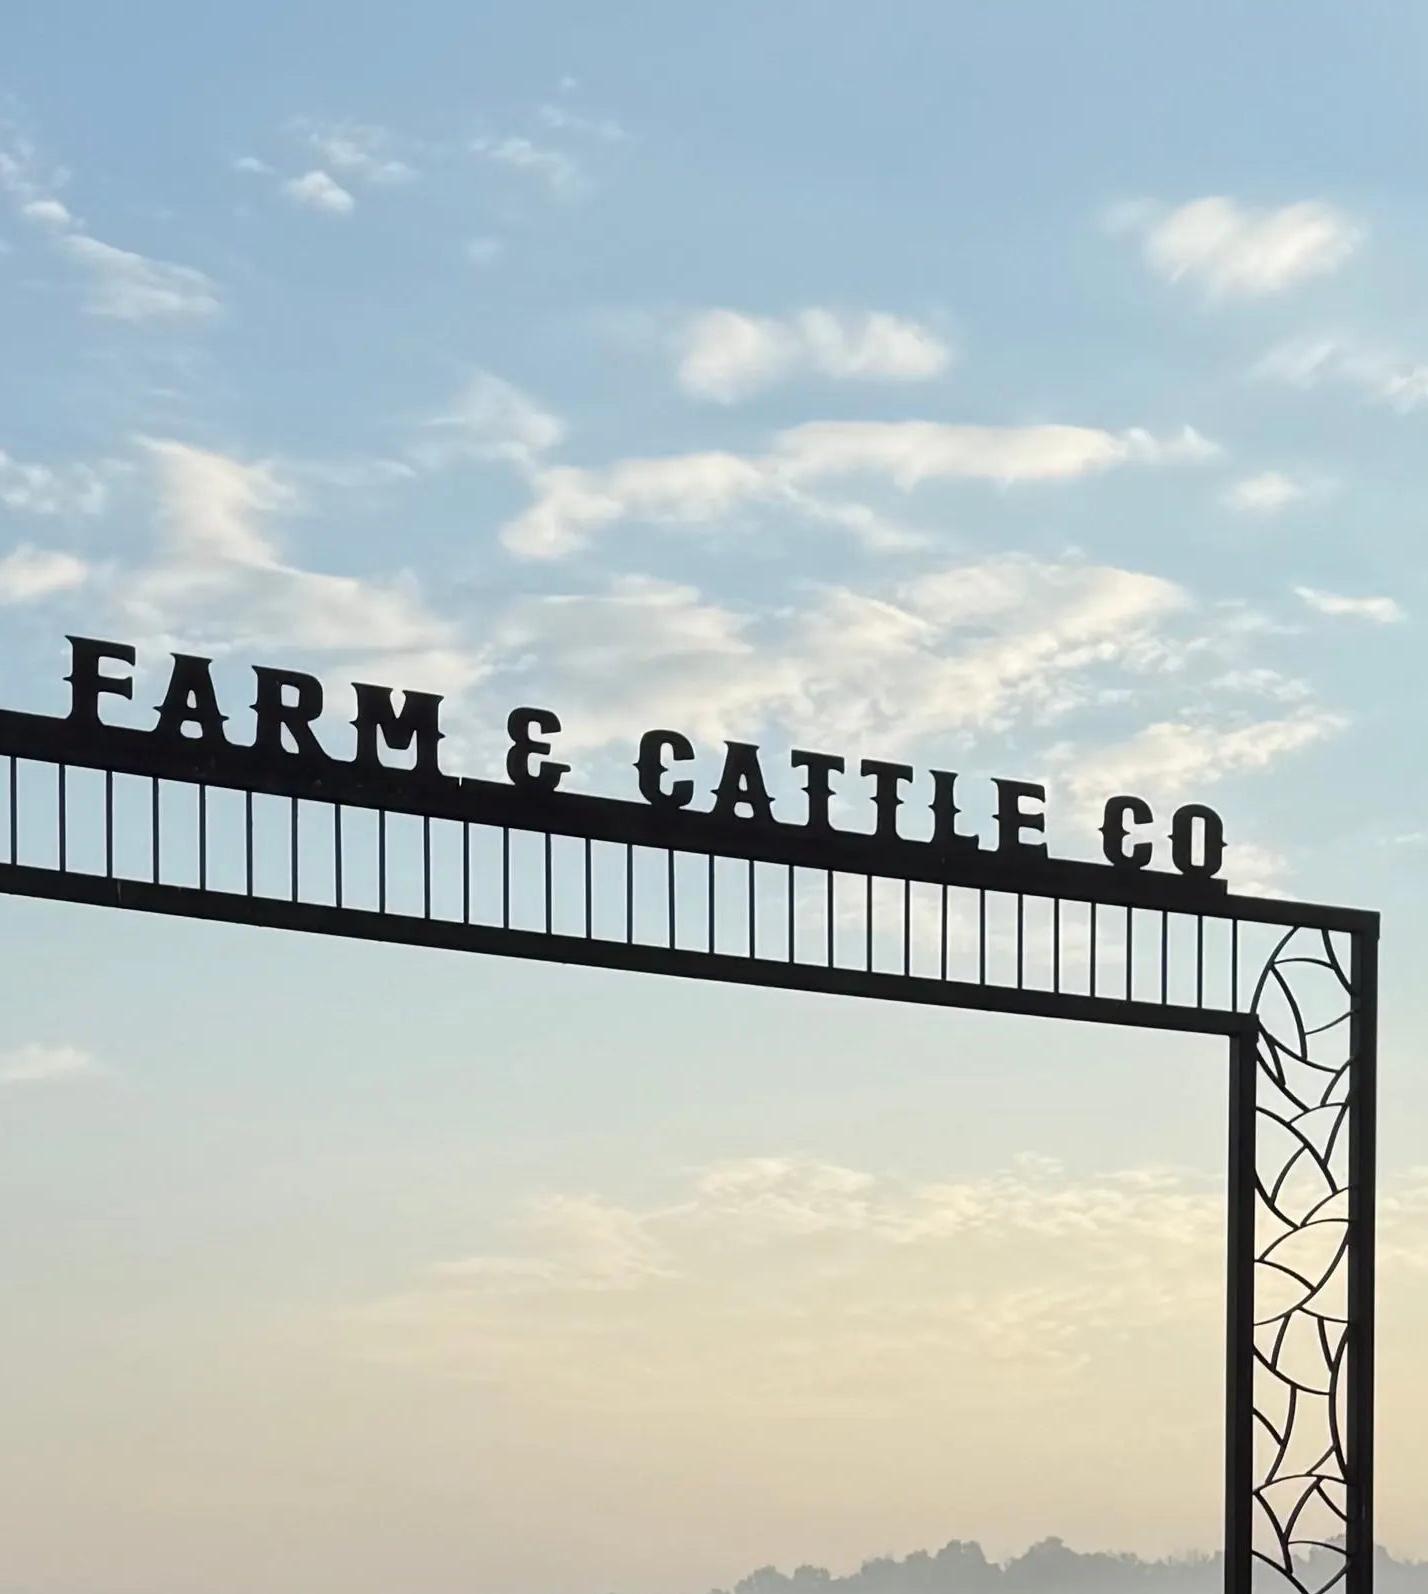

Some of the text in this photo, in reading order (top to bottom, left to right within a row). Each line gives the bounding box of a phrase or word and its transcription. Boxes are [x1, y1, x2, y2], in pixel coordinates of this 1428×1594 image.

[64, 634, 452, 783] FARM
[505, 706, 571, 792] &
[633, 728, 1049, 858] CATTLE
[1097, 795, 1228, 880] CO
